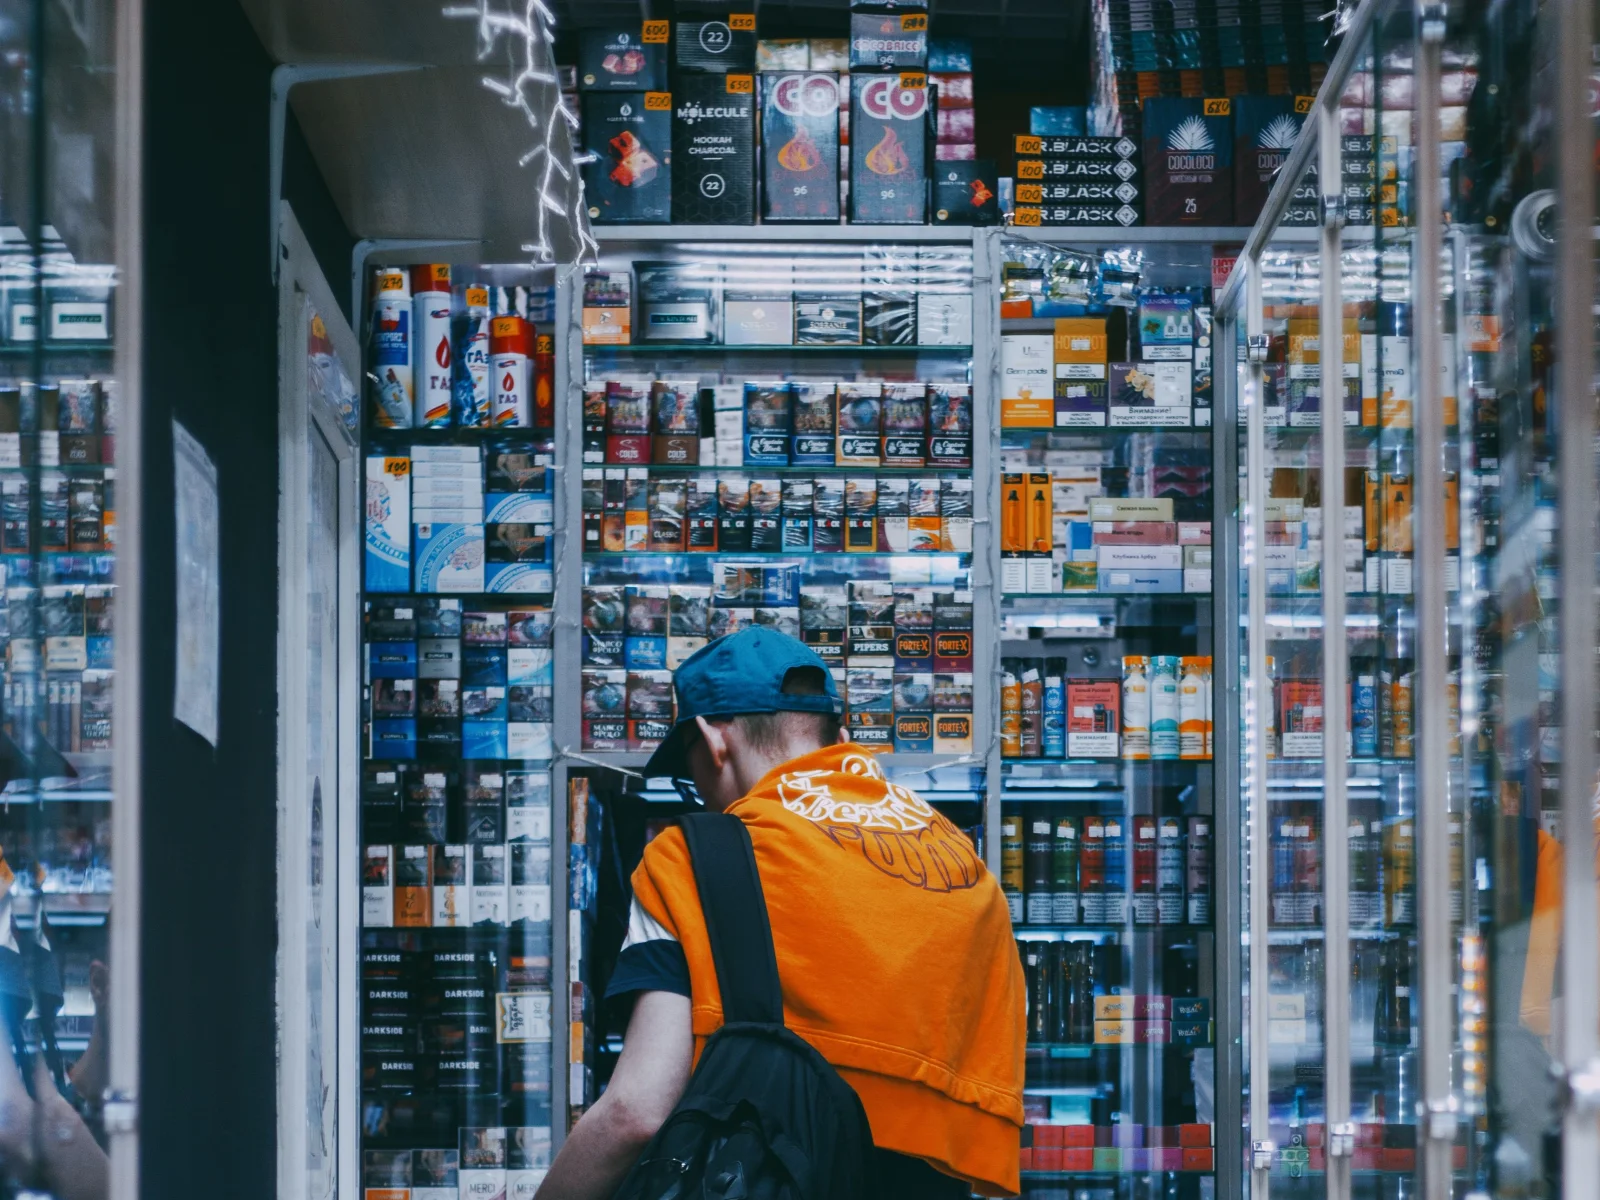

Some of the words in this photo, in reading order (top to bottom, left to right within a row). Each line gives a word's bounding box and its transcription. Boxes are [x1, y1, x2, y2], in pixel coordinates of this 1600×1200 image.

[731, 18, 753, 28] 650
[707, 32, 724, 43] 22
[879, 55, 894, 65] 96
[729, 80, 750, 90] 650
[677, 107, 749, 119] MOLECULE
[693, 136, 732, 144] HOOKAH
[1020, 140, 1040, 151] 100
[1040, 142, 1112, 153] R.BLACK
[688, 147, 737, 155] CHARCOAL
[1168, 155, 1214, 170] COCOLOCO
[1021, 166, 1041, 176] 100
[1041, 164, 1112, 175] R.BLACK
[706, 181, 719, 190] 22
[793, 186, 808, 196] 96
[880, 189, 895, 200] 96
[1020, 189, 1040, 200] 100
[1041, 187, 1113, 198] R.BLACK
[1185, 198, 1197, 214] 25
[1019, 213, 1039, 223] 100
[1040, 209, 1113, 221] R.BLACK
[467, 350, 489, 364] ГАЗ
[498, 394, 518, 405] ГАЗ
[1129, 407, 1172, 415] Внимание!
[667, 450, 688, 459] COLTS
[387, 462, 407, 472] 100
[722, 520, 745, 528] BLCK
[853, 642, 889, 652] PIPERS
[899, 639, 929, 651] FORTE-X
[938, 639, 968, 651] FORTE-X
[593, 724, 624, 732] MARCO
[638, 724, 669, 732] MARCO
[899, 721, 929, 733] FORTE-X
[938, 721, 968, 733] FORTE-X
[598, 730, 621, 738] POLO
[643, 730, 666, 738] POLO
[852, 730, 888, 740] PIPERS
[434, 953, 475, 962] DARKSIDE
[369, 990, 409, 999] DARKSIDE
[445, 989, 485, 998] DARKSIDE
[363, 1026, 403, 1035] DARKSIDE
[382, 1062, 414, 1070] DARKSID
[439, 1061, 480, 1070] DARKSIDE
[469, 1183, 496, 1193] MERCI
